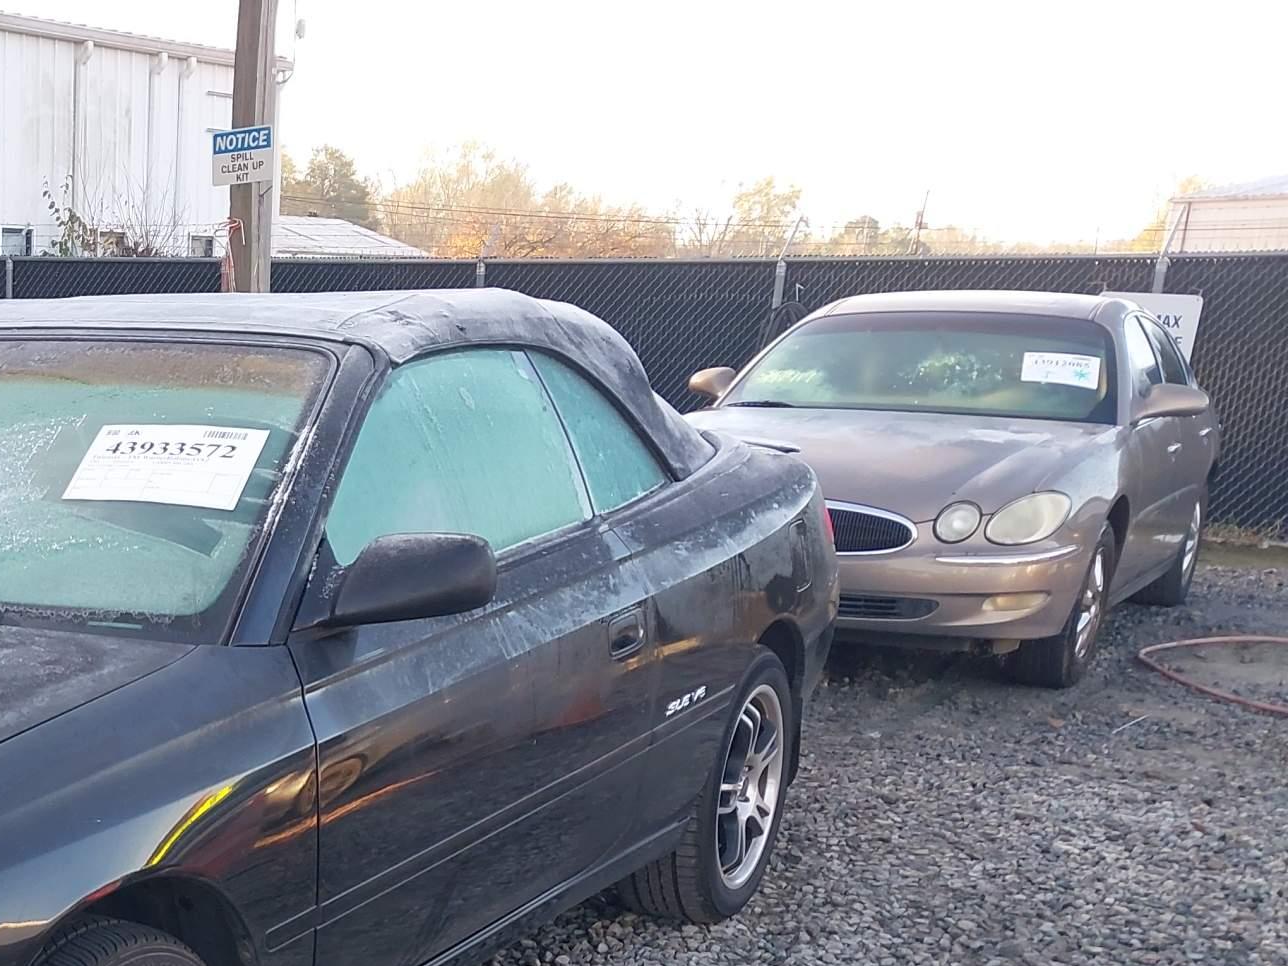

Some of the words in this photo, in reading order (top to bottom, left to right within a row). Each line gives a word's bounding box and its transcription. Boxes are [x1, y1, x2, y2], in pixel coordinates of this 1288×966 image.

[215, 130, 269, 151] NOTICE
[231, 152, 254, 163] SPILL
[221, 163, 249, 174] CLEAN
[252, 161, 264, 170] UP
[236, 173, 249, 182] KIT
[105, 441, 238, 459] 43933572
